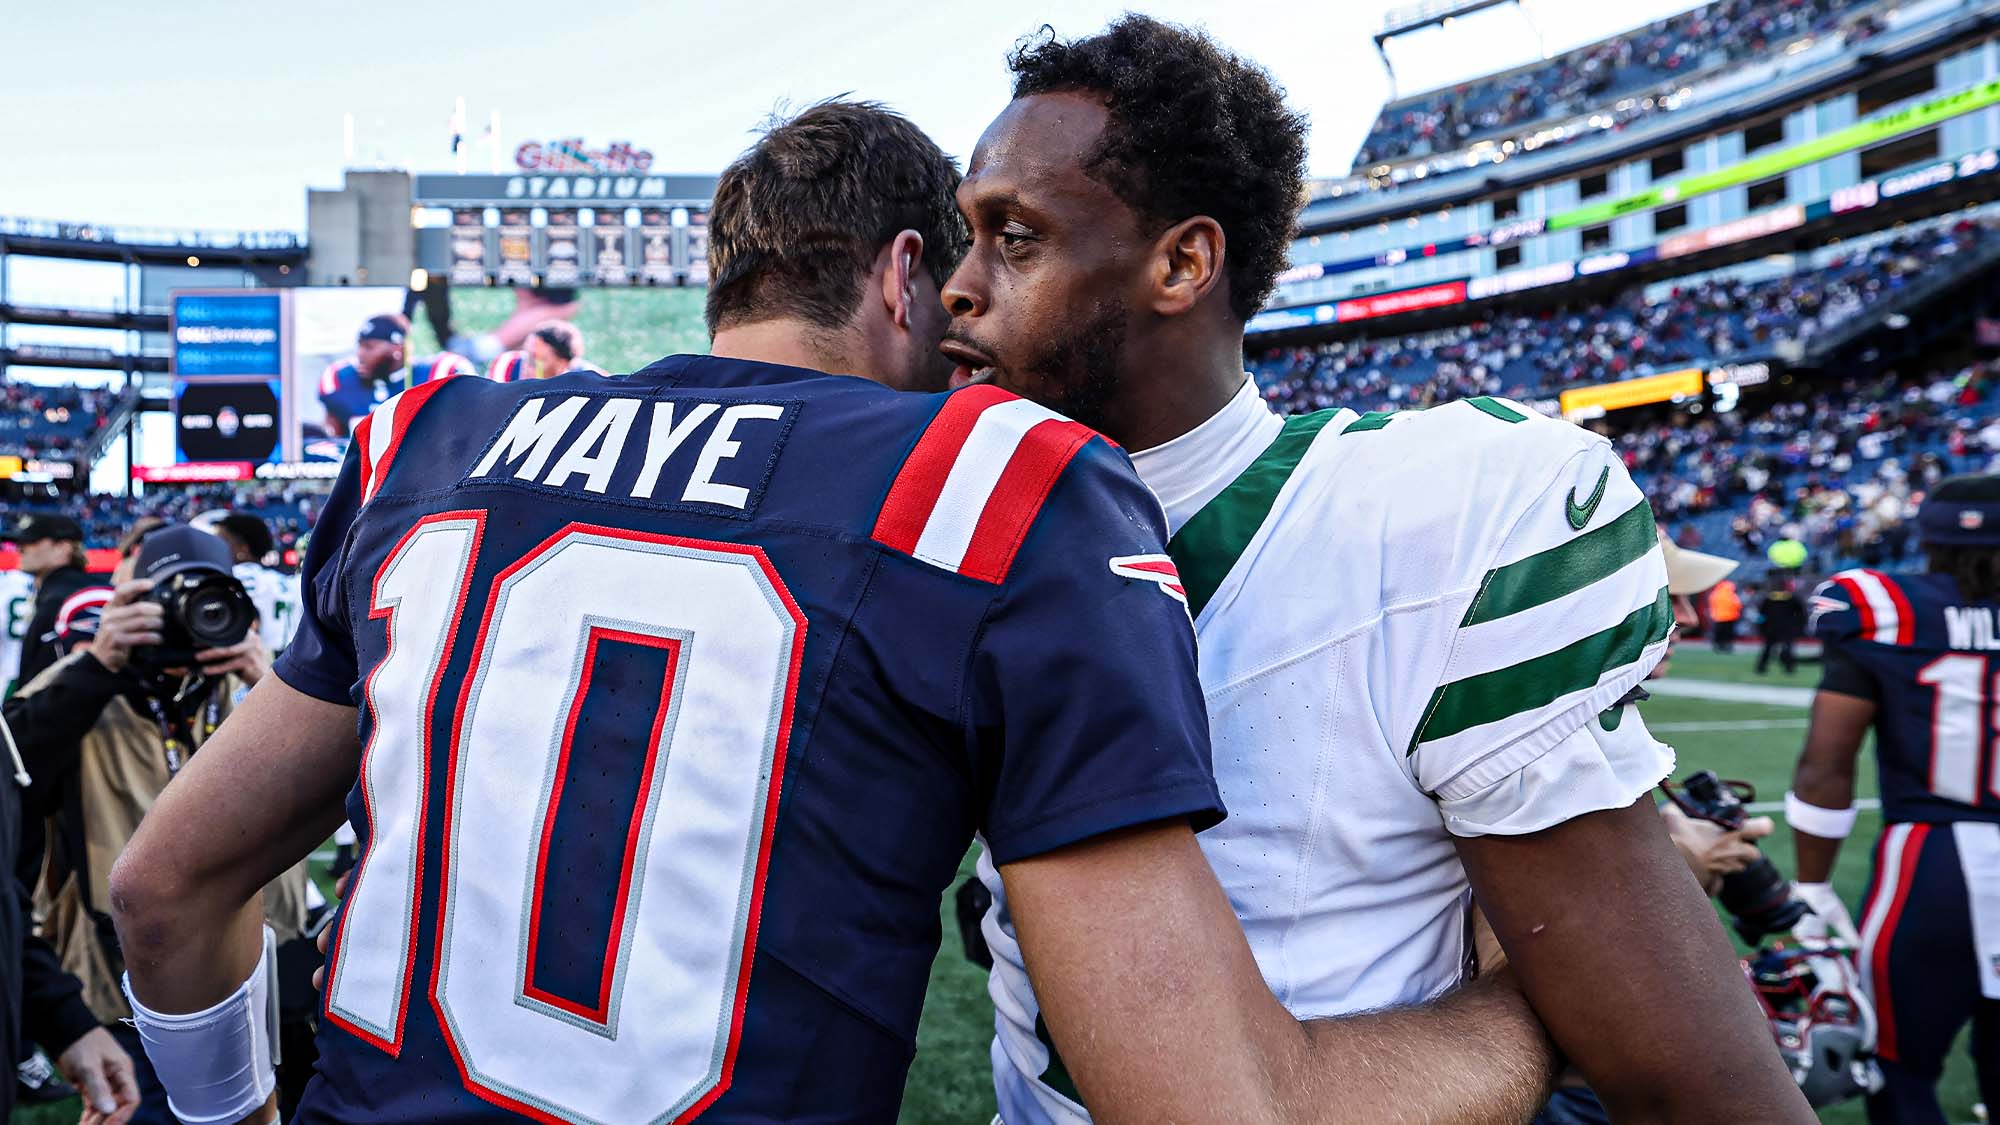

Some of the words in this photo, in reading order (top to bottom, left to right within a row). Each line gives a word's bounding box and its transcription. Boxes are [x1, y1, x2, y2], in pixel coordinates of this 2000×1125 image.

[505, 176, 666, 198] STADIUM
[515, 137, 653, 172] Gillette
[471, 396, 783, 509] MAYE
[1944, 606, 2000, 650] WIL
[1917, 653, 2000, 807] 1
[325, 508, 808, 1125] 10
